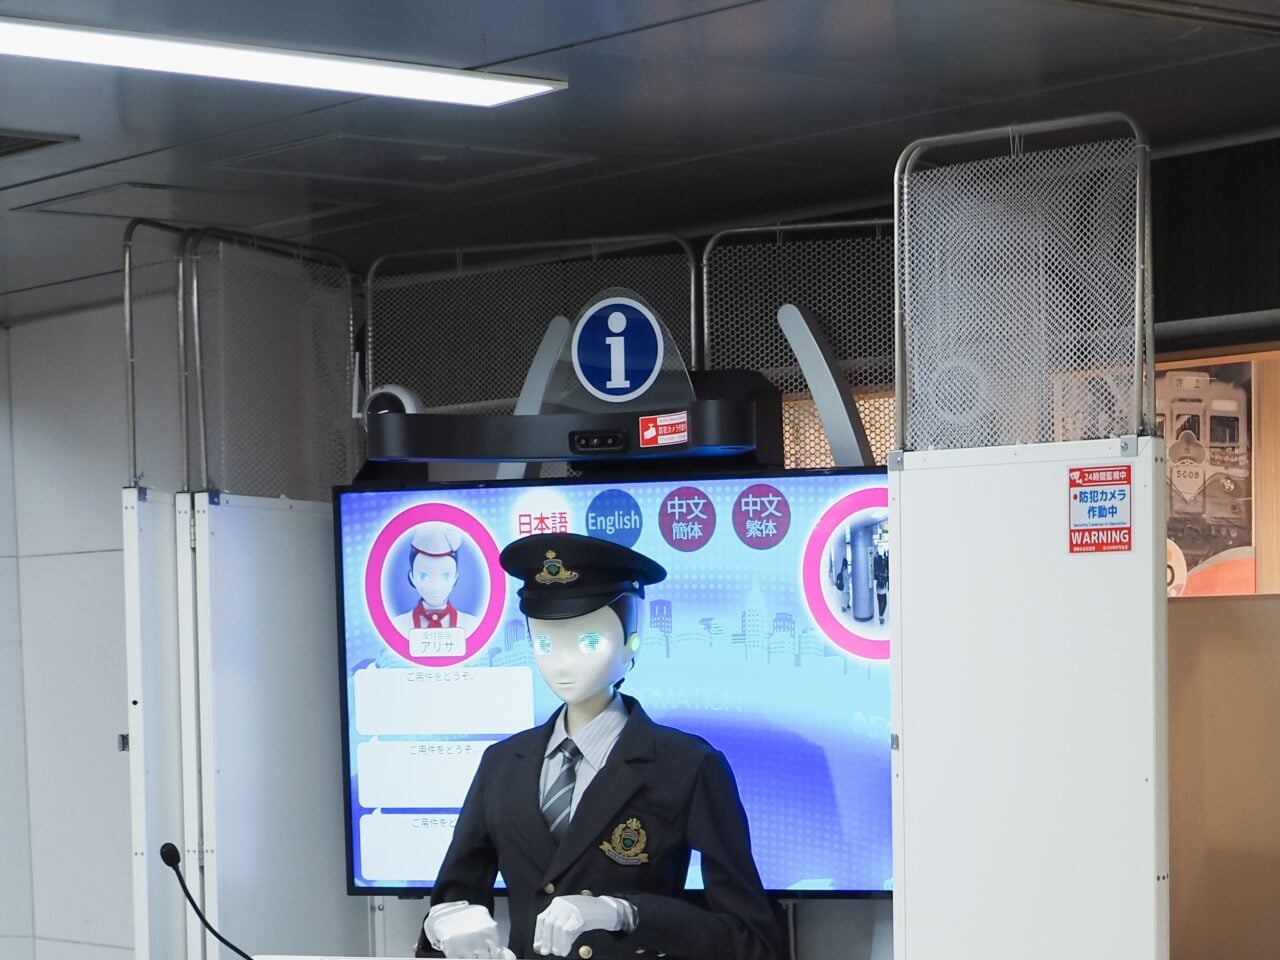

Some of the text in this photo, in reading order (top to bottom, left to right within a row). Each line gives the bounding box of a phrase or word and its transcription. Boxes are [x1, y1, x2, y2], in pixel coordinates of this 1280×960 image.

[741, 493, 782, 518] 中文
[1079, 489, 1126, 503] 防犯カメラ
[667, 496, 708, 520] 中文
[1088, 505, 1117, 519] 作動中
[518, 512, 569, 534] 日本語
[588, 510, 640, 534] English
[671, 521, 703, 540] 簡体
[746, 519, 778, 538] 繁体
[1071, 529, 1129, 545] WARNING
[421, 641, 455, 653] アリサ
[407, 671, 475, 682] ご用件をどうぞ。
